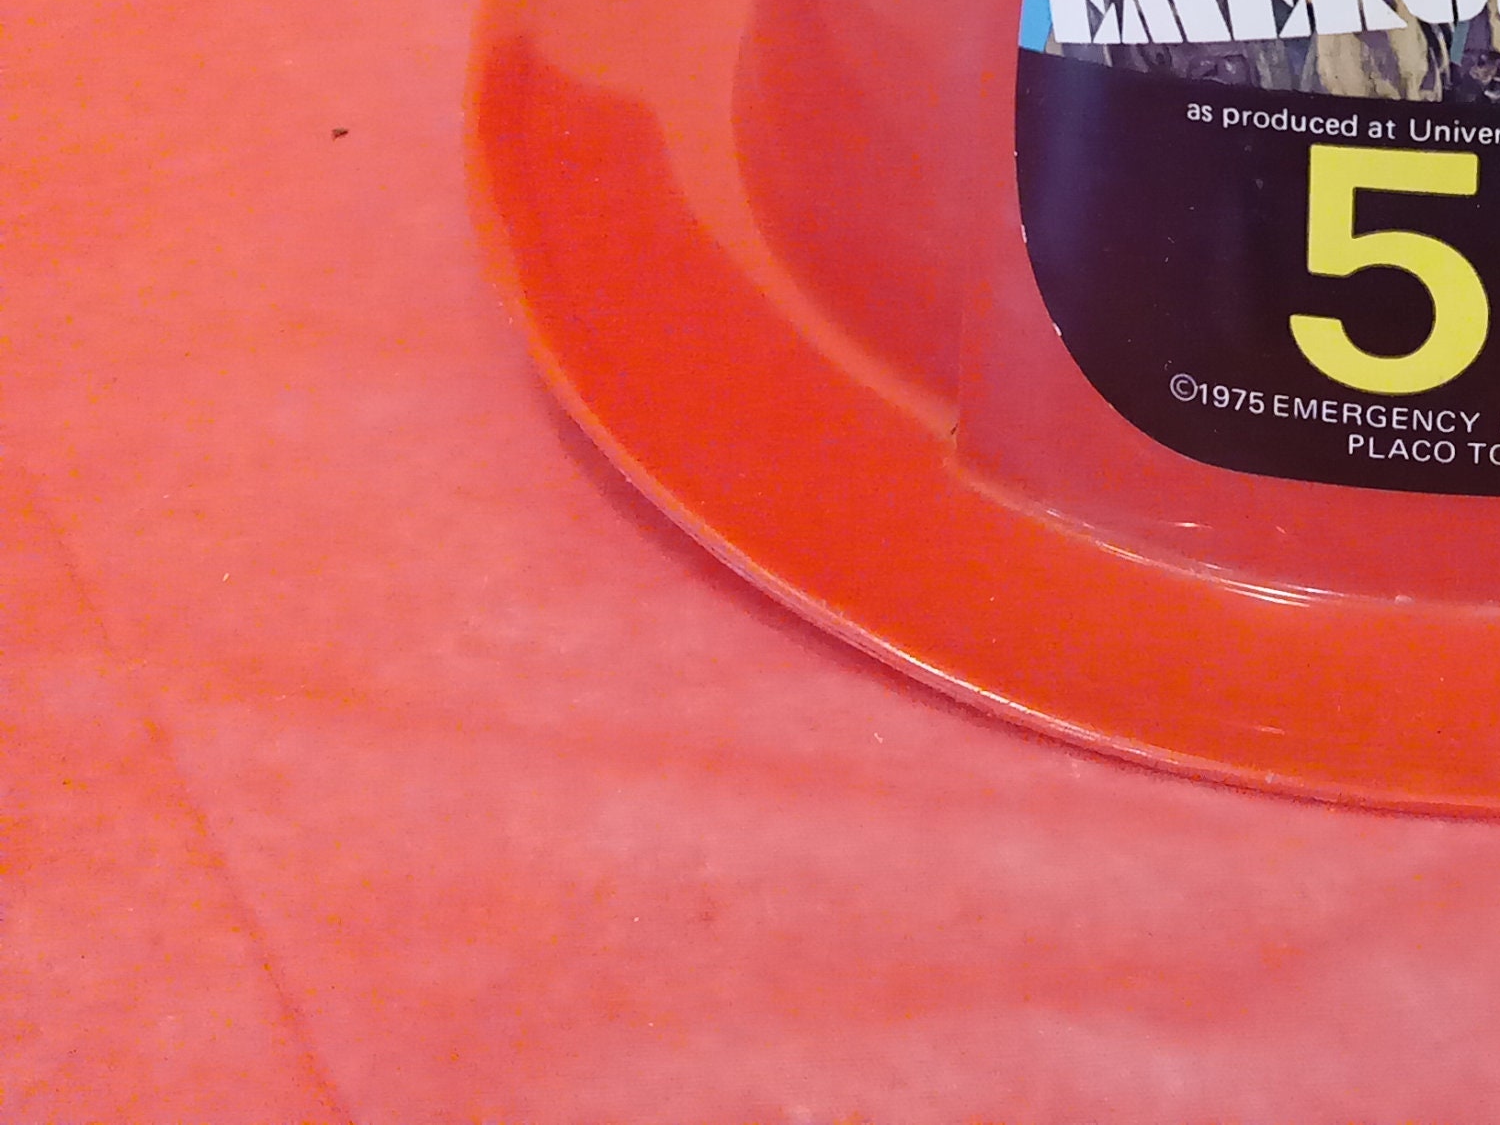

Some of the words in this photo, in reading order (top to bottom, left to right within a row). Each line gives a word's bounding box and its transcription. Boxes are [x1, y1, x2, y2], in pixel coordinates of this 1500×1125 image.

[1186, 103, 1213, 122] as
[1222, 106, 1359, 137] produced
[1368, 119, 1396, 140] at
[1273, 395, 1482, 434] EMERGENCY
[1348, 433, 1456, 463] PLACO
